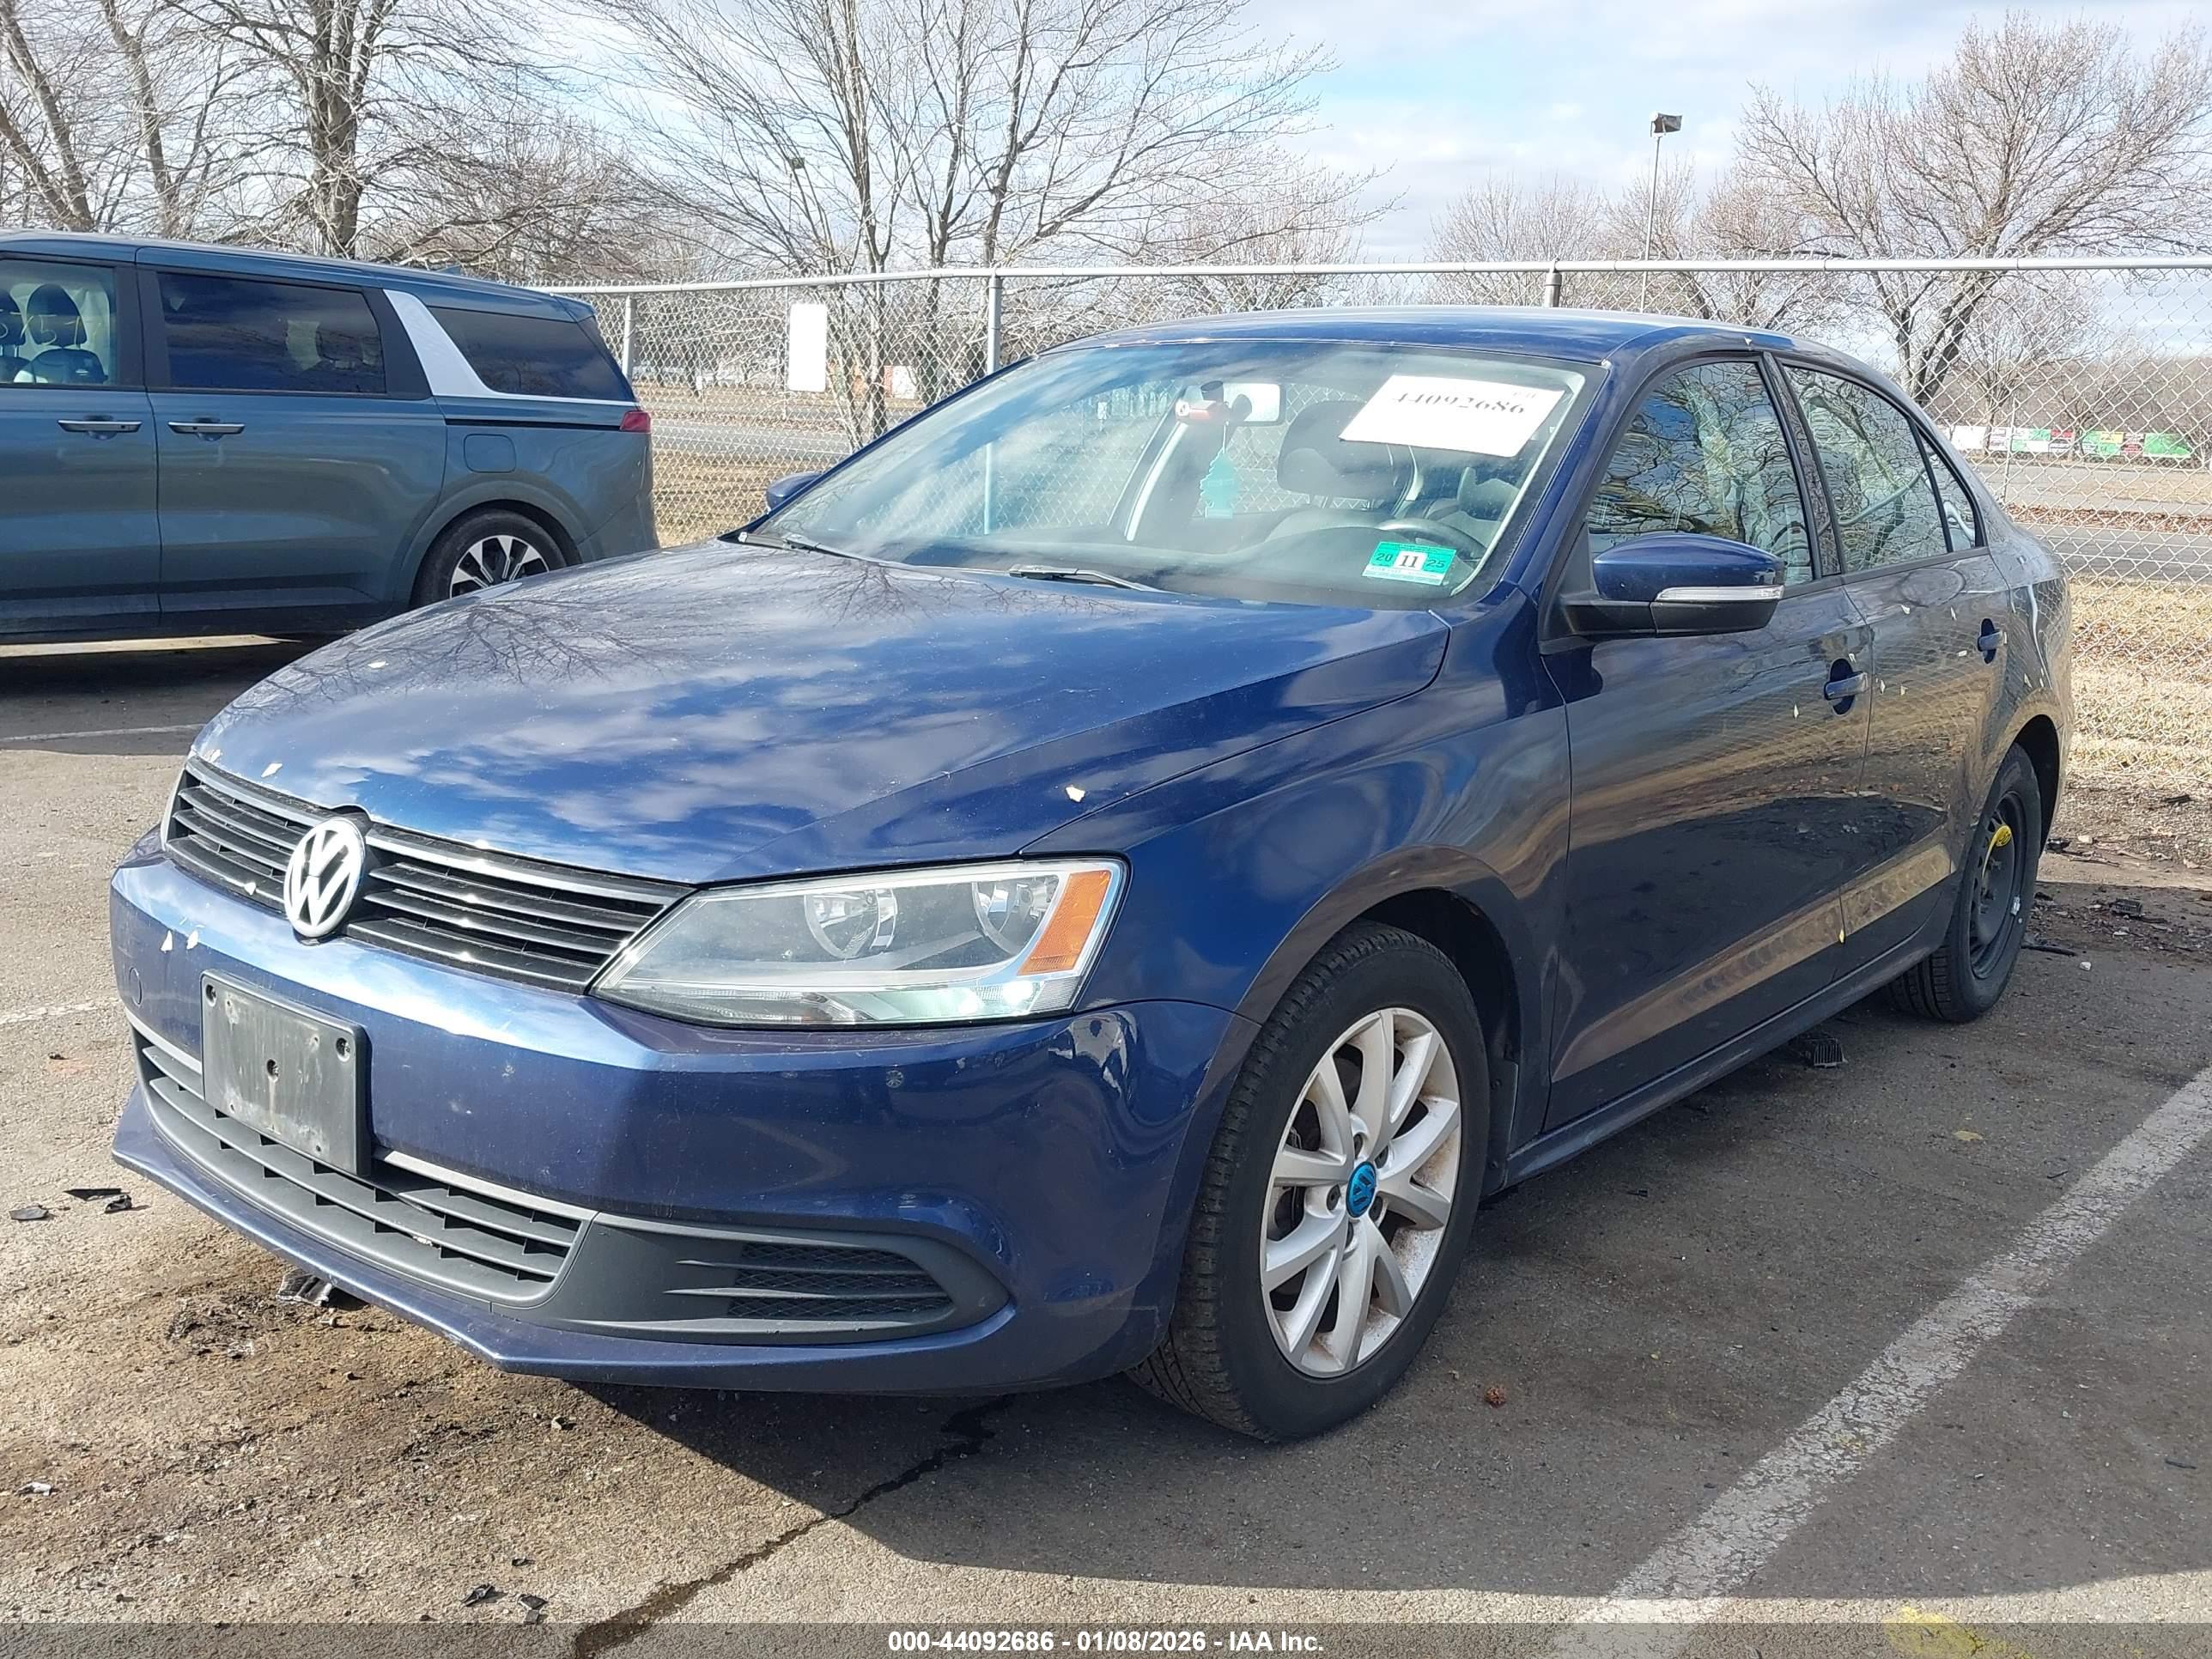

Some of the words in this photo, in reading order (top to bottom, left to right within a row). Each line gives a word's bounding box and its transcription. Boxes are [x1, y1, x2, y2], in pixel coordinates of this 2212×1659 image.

[1376, 552, 1393, 562] 20
[1398, 555, 1419, 568] 11
[1426, 559, 1446, 568] 25
